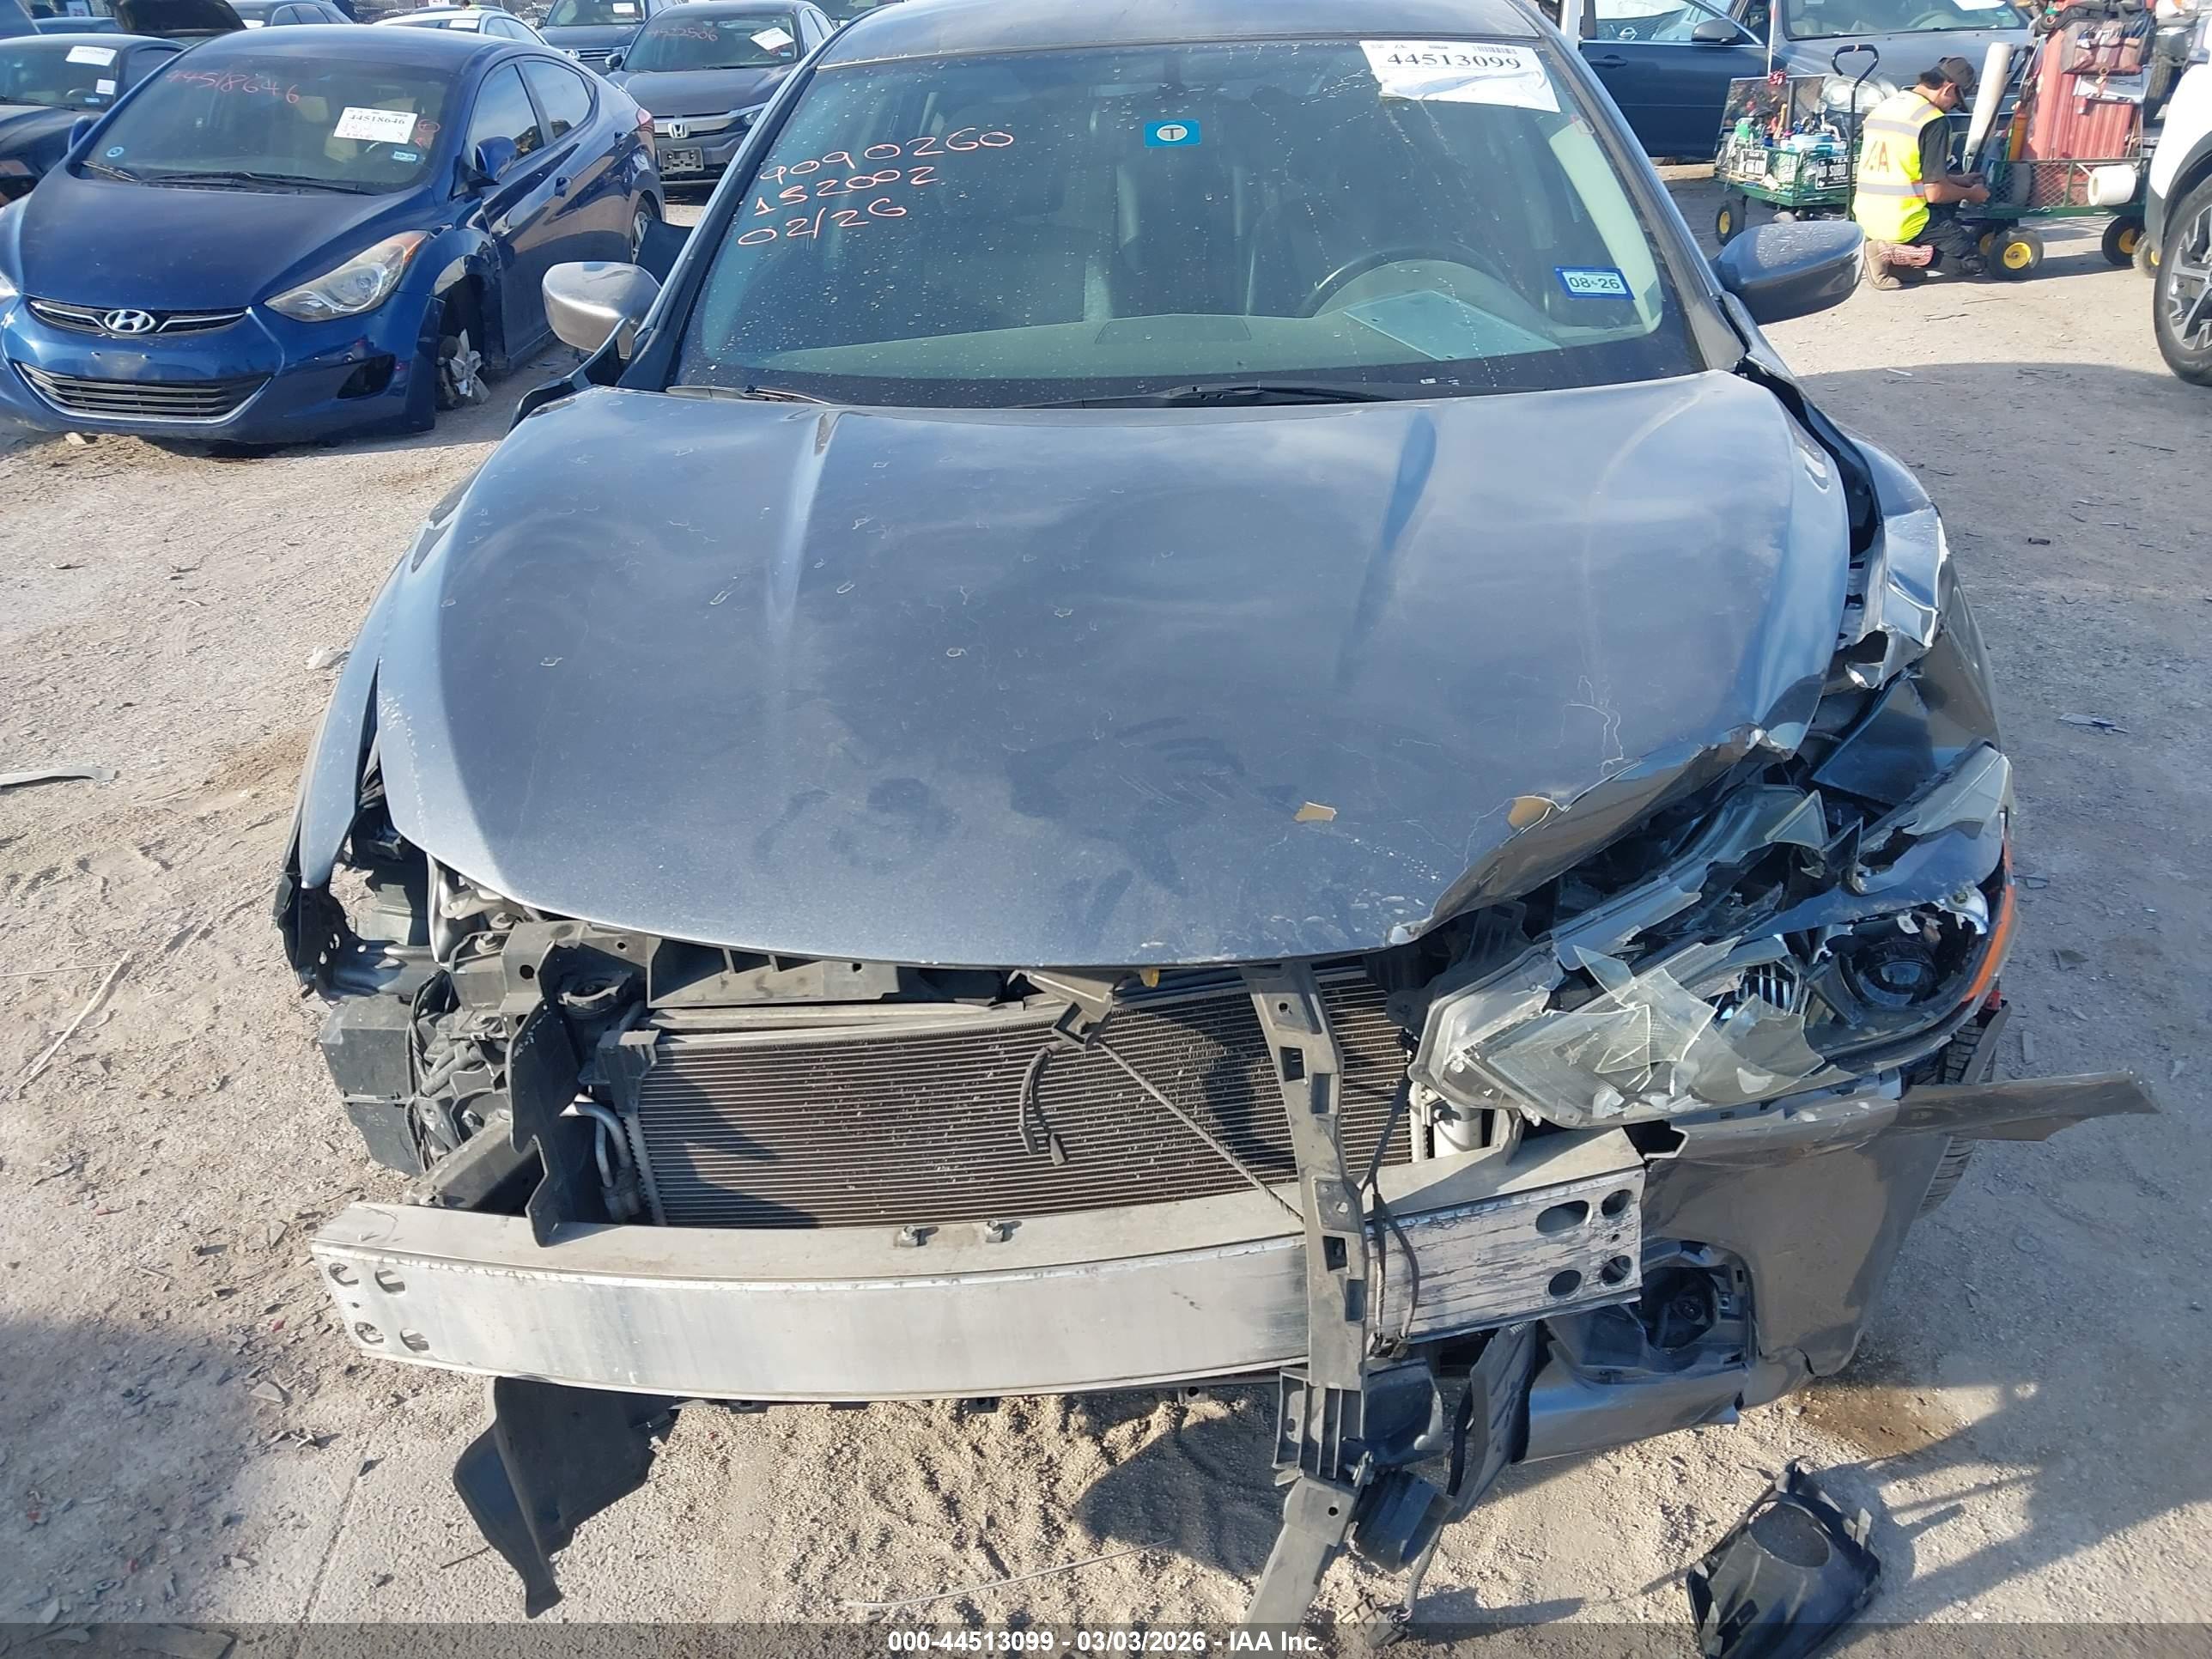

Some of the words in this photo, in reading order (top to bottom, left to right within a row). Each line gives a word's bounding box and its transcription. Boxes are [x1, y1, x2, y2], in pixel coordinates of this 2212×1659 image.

[1388, 53, 1521, 70] 44513099
[759, 127, 1014, 185] 9090260
[737, 198, 908, 245] 02/26
